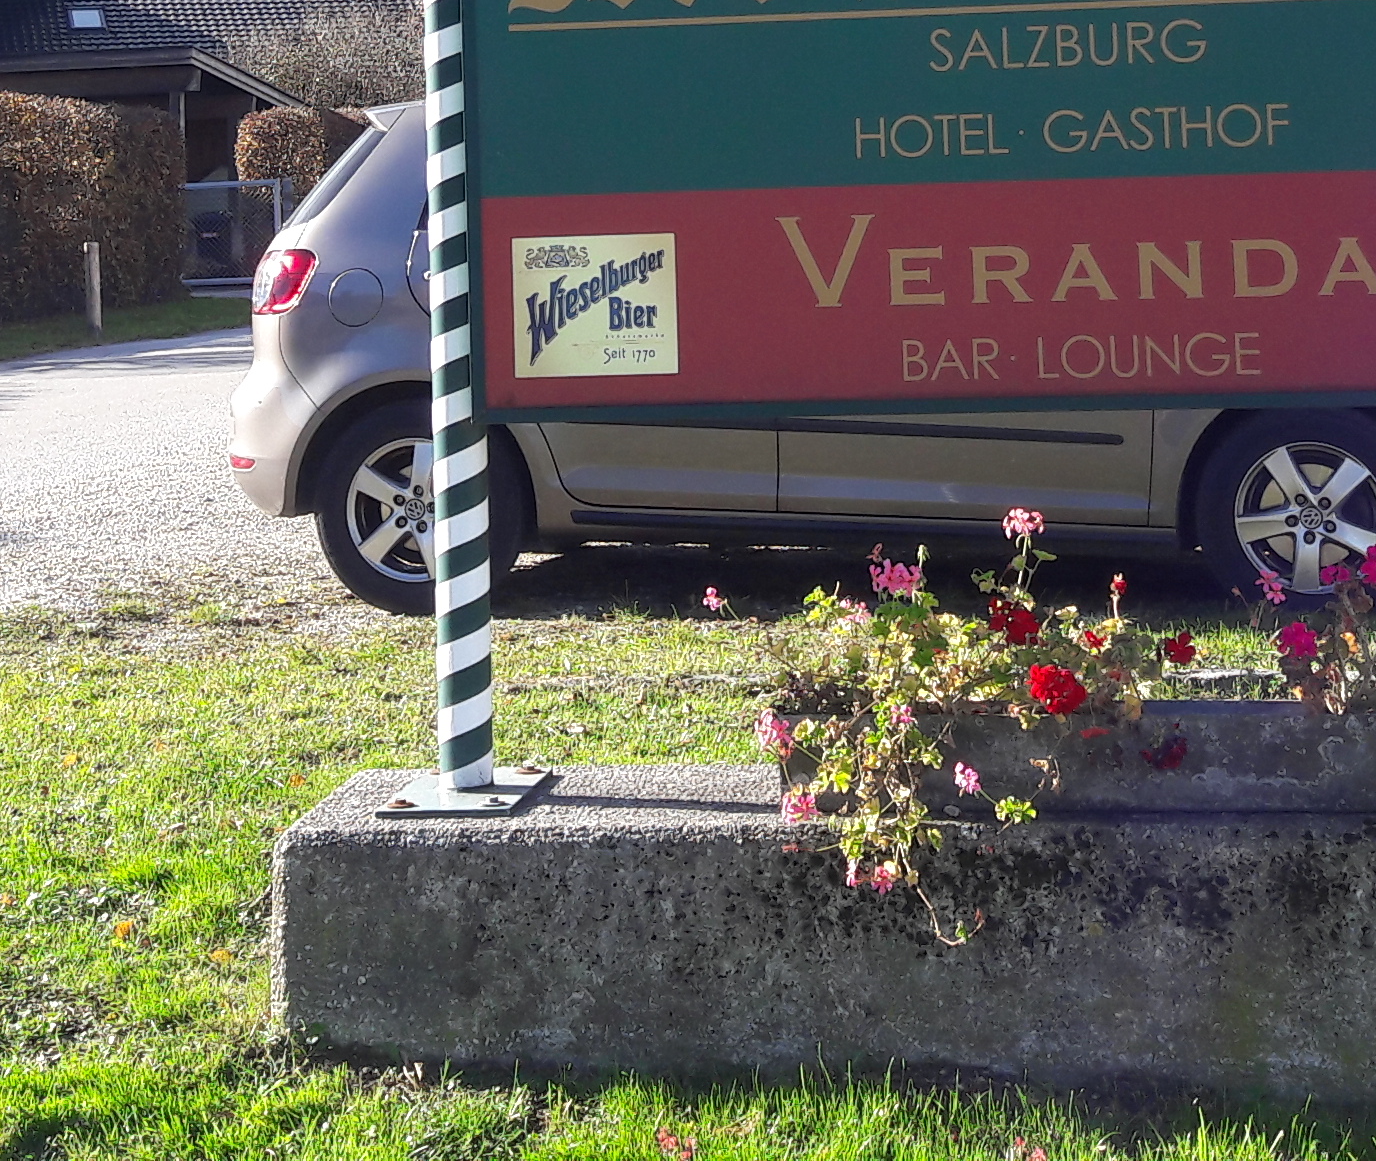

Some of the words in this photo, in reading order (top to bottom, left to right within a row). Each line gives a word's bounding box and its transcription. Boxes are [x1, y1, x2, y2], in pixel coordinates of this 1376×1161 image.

[928, 18, 1208, 72] SALZBURG
[854, 112, 1010, 158] HOTEL
[1042, 102, 1291, 154] GASTHOF
[525, 249, 665, 366] Wieselburger
[608, 296, 658, 331] Bier
[603, 347, 627, 365] Seit
[632, 349, 656, 364] 1770
[902, 338, 1000, 382] BAR
[1037, 332, 1262, 380] LOUNGE
